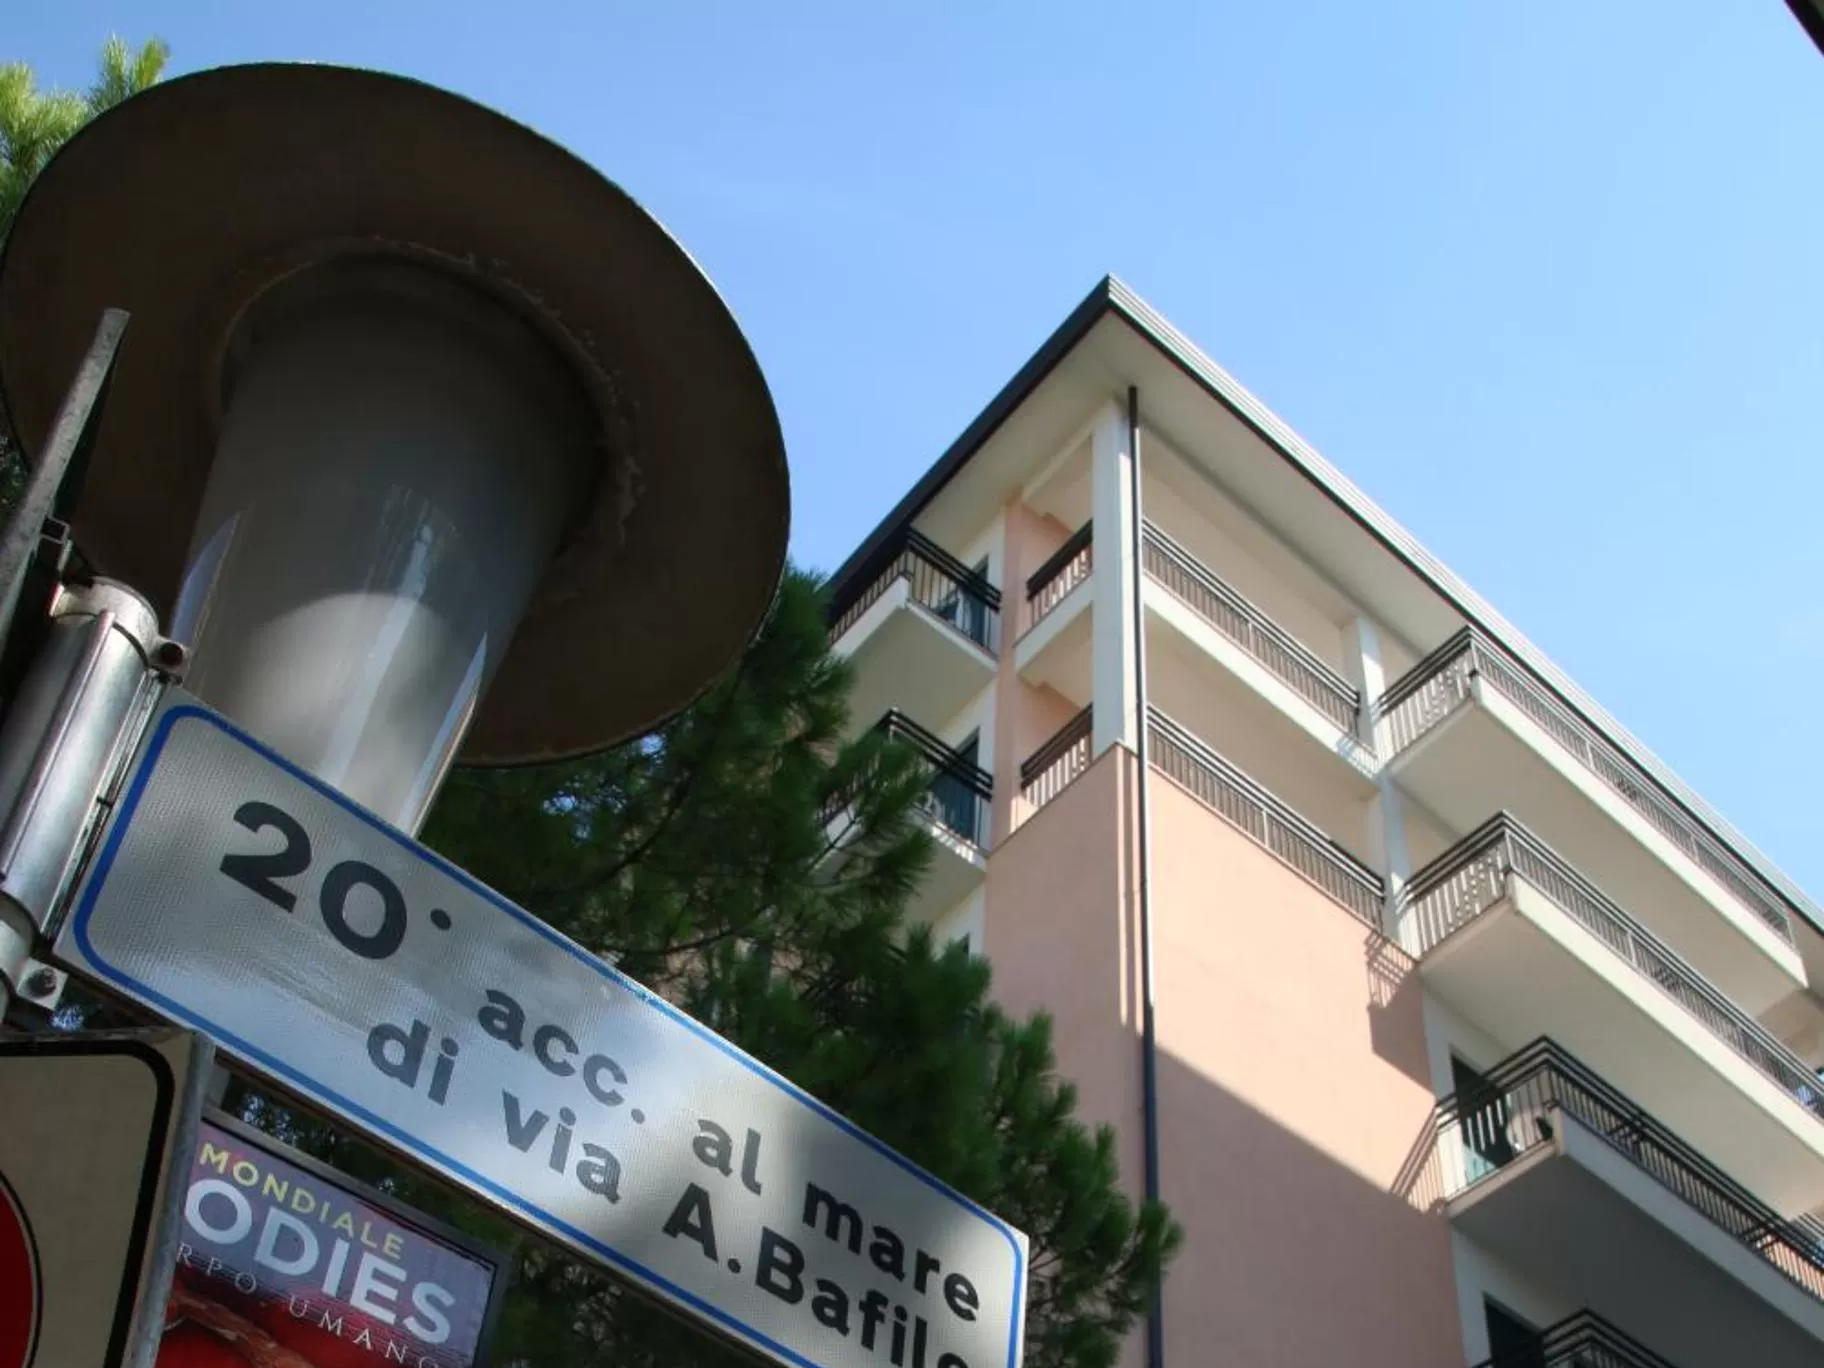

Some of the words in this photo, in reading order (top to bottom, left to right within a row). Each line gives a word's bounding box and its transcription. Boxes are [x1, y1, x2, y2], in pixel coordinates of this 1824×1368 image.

[366, 1019, 460, 1106] di
[502, 1089, 622, 1205] via
[478, 989, 646, 1124] acc.
[692, 1119, 762, 1196] al
[803, 1181, 979, 1322] mare
[185, 1178, 457, 1345] ODIES
[199, 1143, 406, 1258] MONDIALE
